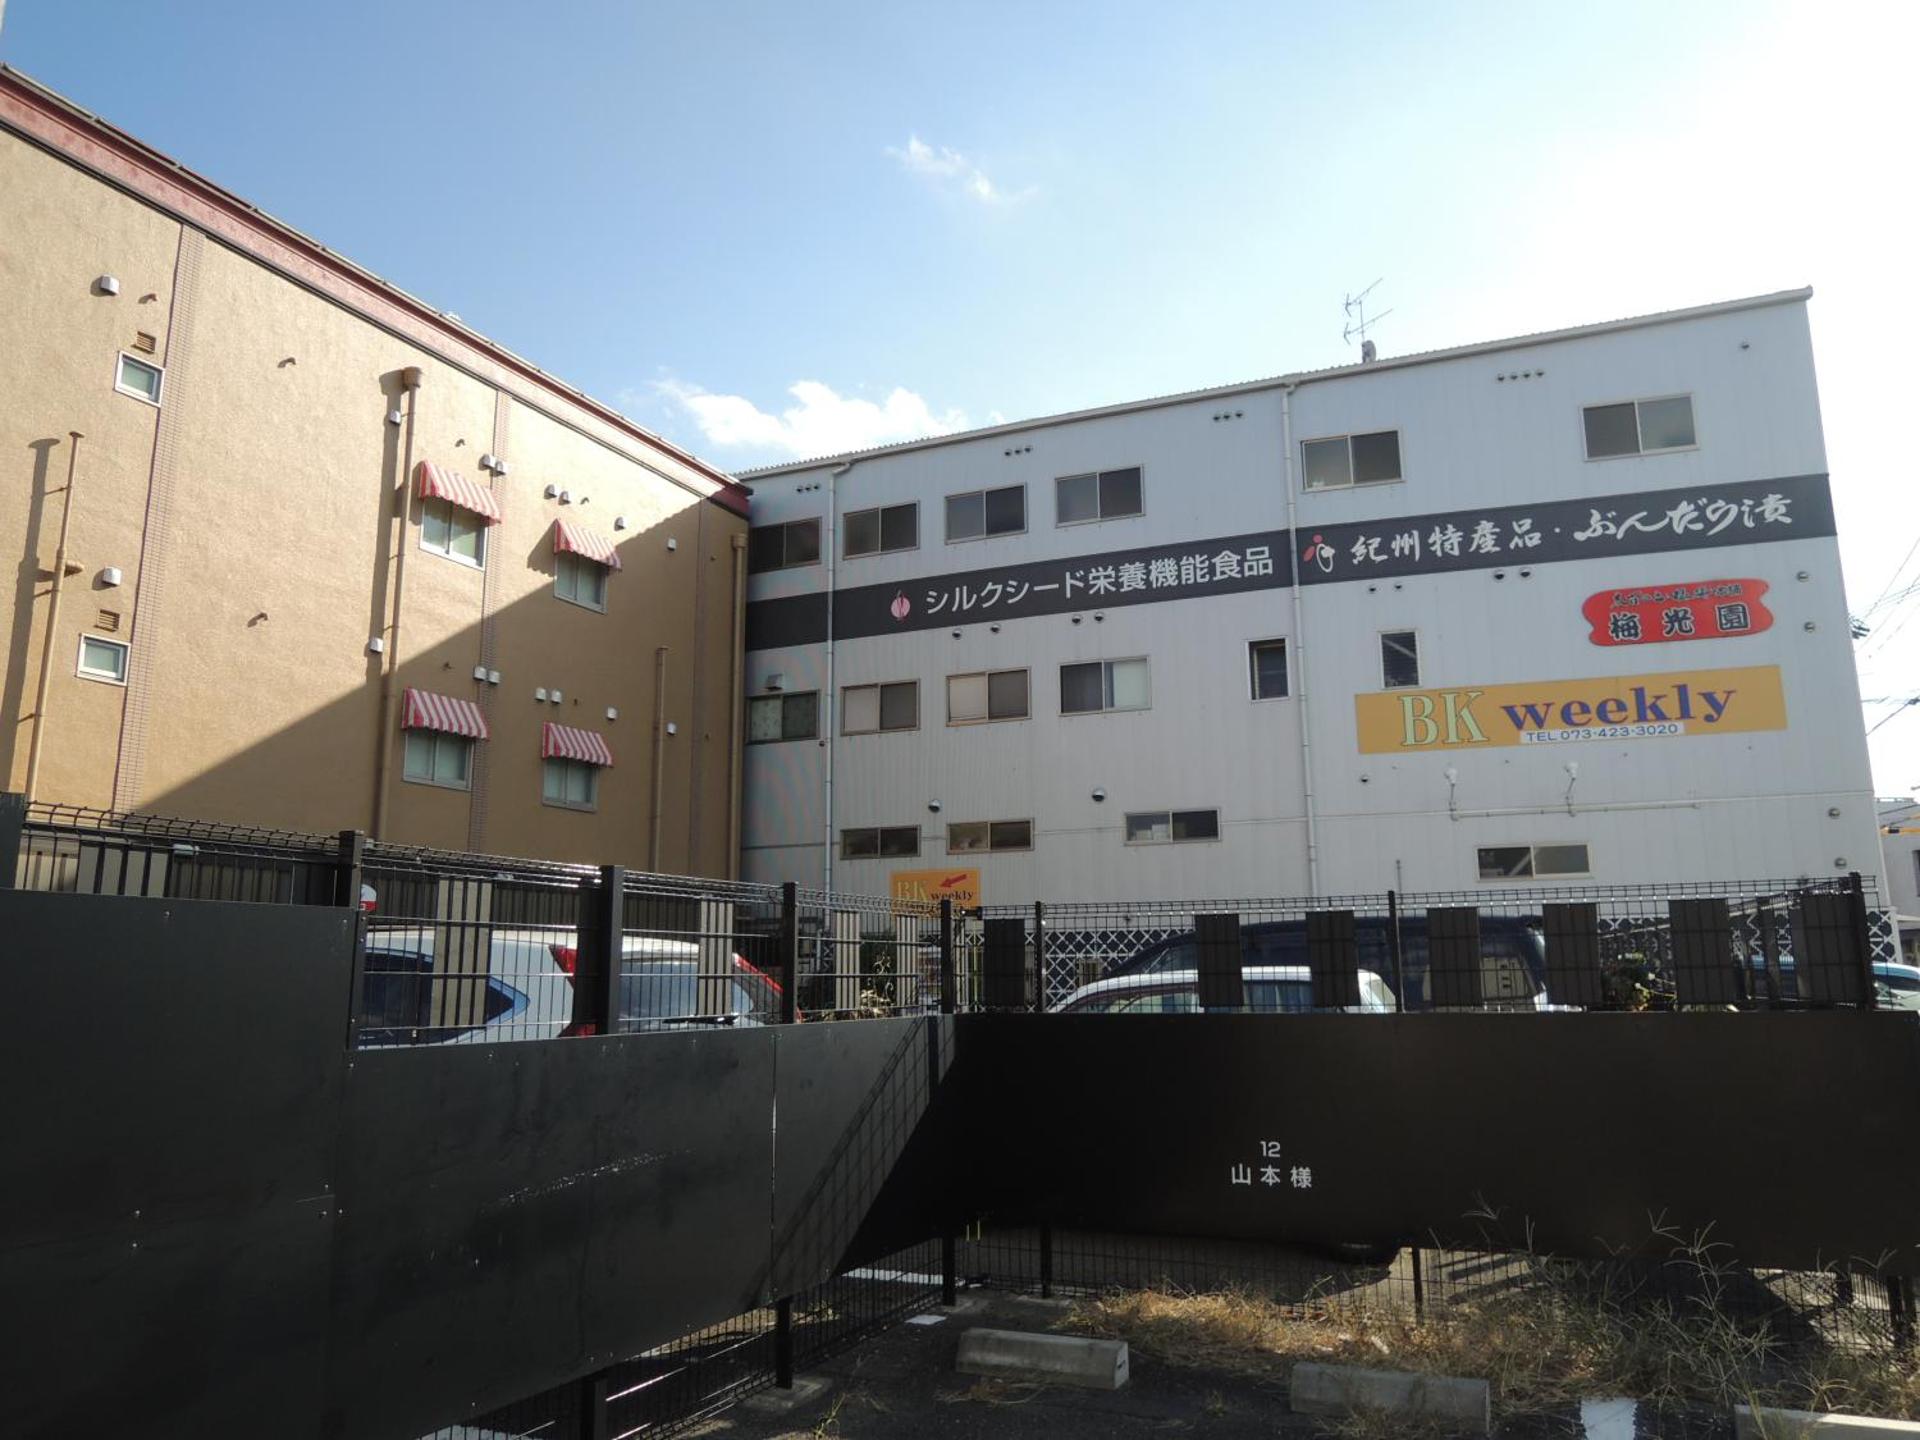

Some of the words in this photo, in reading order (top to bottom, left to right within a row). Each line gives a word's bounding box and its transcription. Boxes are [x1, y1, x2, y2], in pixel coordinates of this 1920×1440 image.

[925, 545, 1273, 615] シルクシード栄養機能食品
[1609, 602, 1751, 640] 梅光園
[1397, 690, 1490, 747] BK
[1500, 683, 1737, 732] weekly
[1526, 731, 1558, 742] TEL
[896, 880, 928, 902] BK
[930, 890, 974, 902] weekly
[1259, 1140, 1281, 1158] 12
[1231, 1163, 1312, 1189] 山本様
